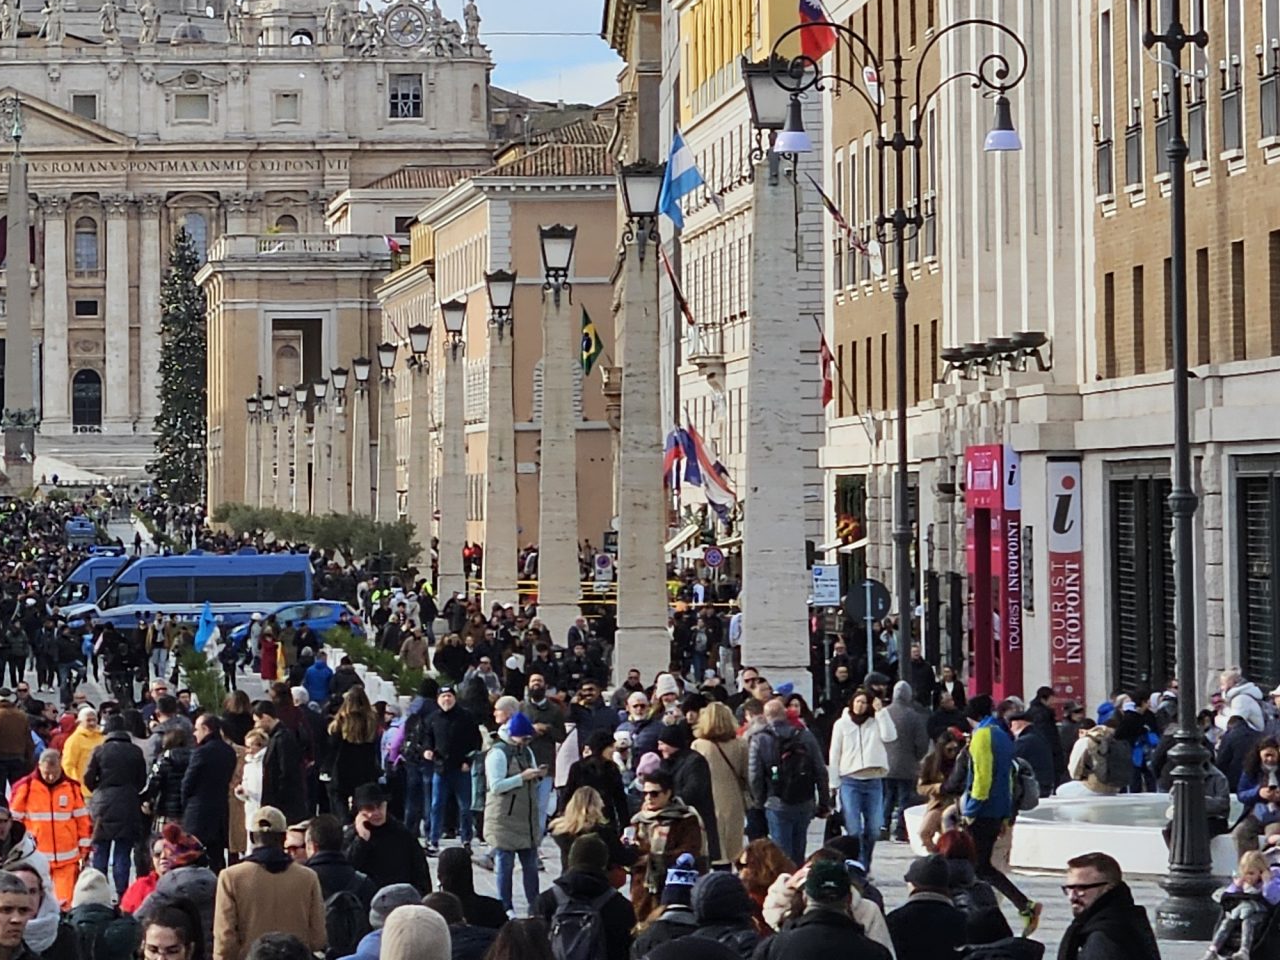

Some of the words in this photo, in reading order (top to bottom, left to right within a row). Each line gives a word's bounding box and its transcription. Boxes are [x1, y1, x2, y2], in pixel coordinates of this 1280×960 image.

[51, 161, 127, 172] ROMANVS
[129, 161, 167, 172] PONT
[167, 160, 198, 171] MAX
[284, 160, 321, 171] PONT
[326, 159, 348, 170] VII
[1052, 475, 1076, 535] i
[1007, 520, 1020, 592] INFOPOINT
[1009, 597, 1021, 653] TOURIST
[1051, 560, 1067, 665] TOURIST
[1065, 559, 1082, 665] INFOPOINT
